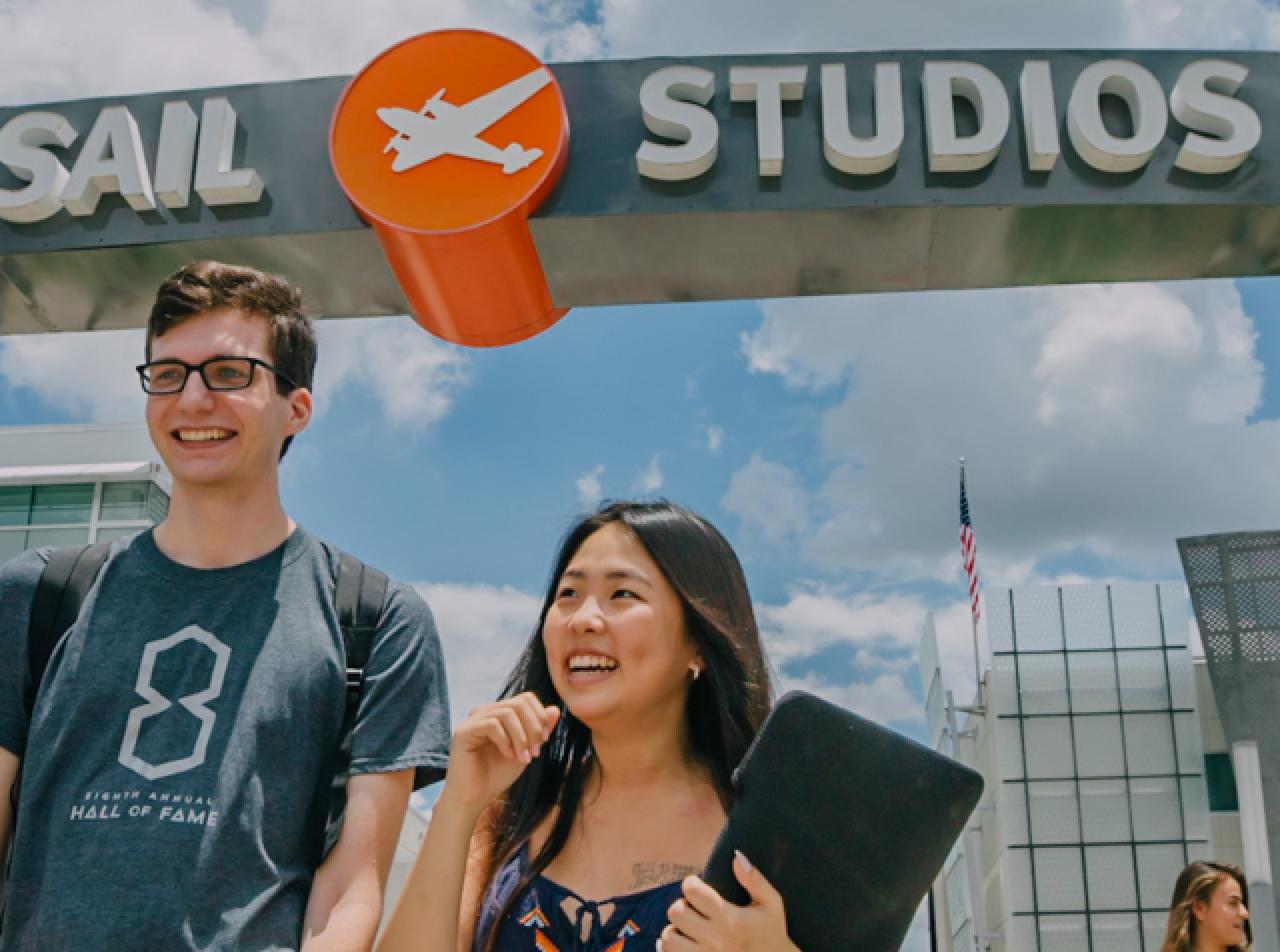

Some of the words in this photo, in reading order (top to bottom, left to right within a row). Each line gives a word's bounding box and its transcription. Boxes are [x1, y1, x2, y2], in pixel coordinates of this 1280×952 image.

[635, 59, 1262, 182] STUDIOS
[118, 624, 232, 780] 8
[70, 804, 120, 821] HALL
[128, 805, 153, 817] OF
[159, 805, 219, 827] FAME
[148, 791, 211, 805] ANNUAL
